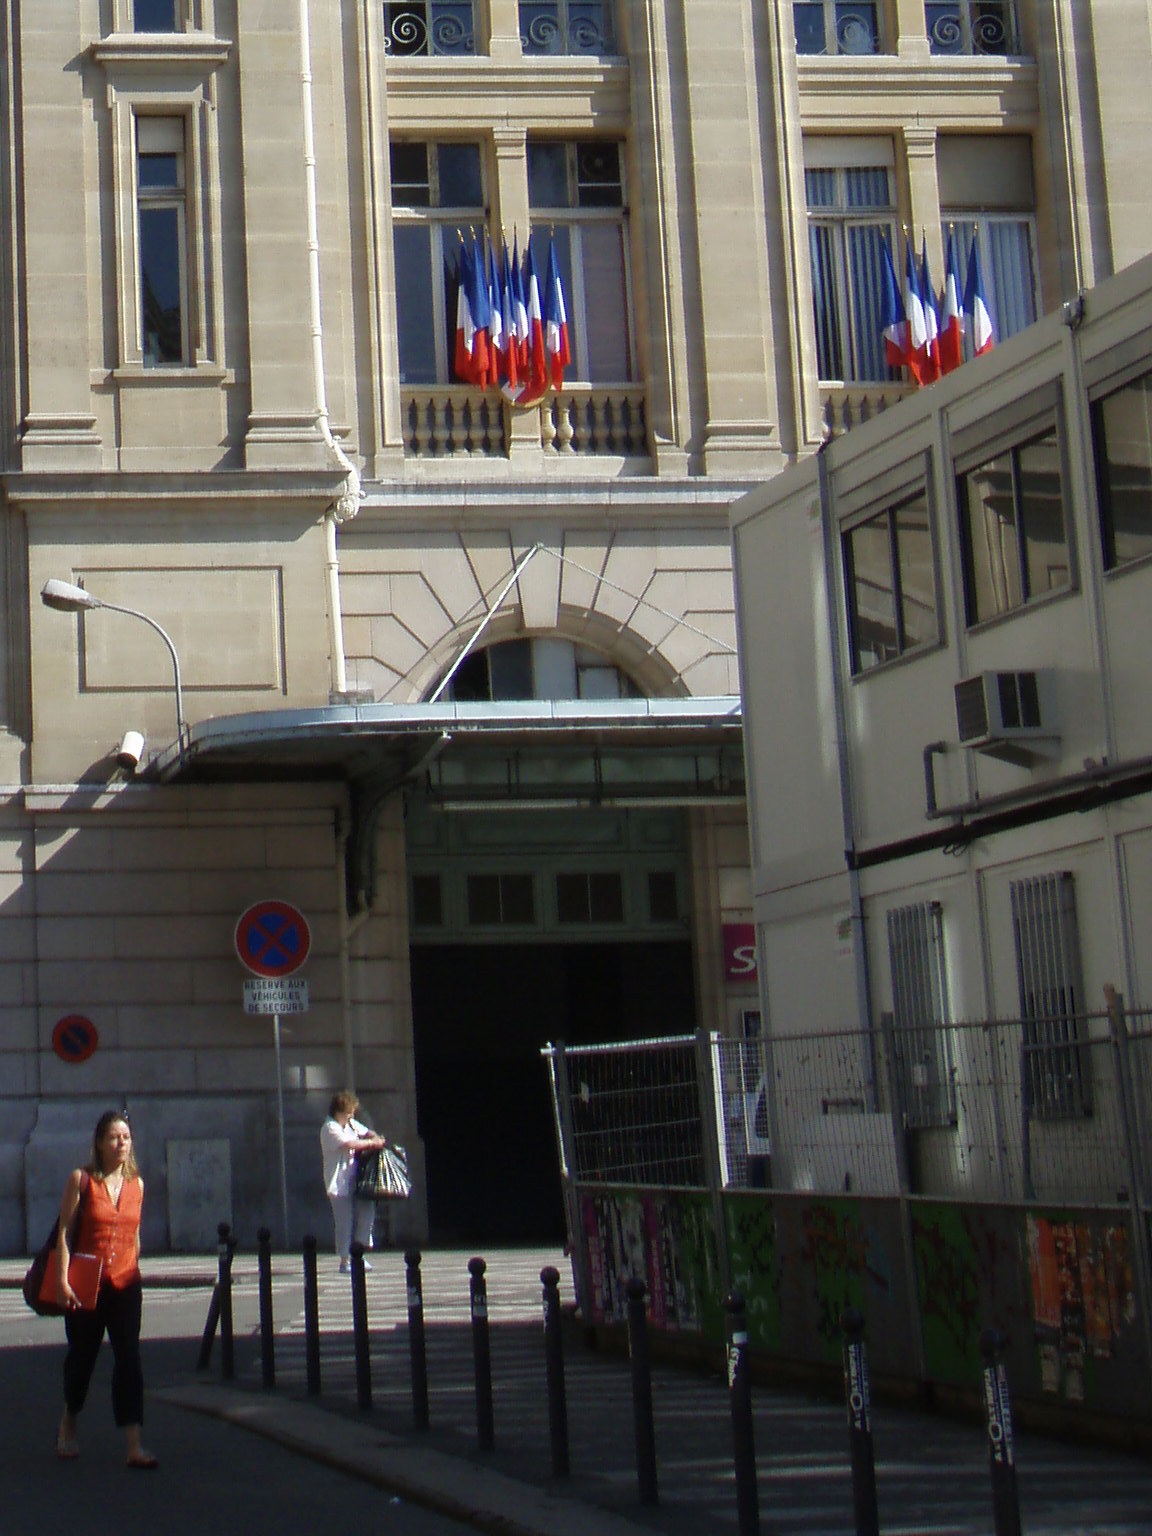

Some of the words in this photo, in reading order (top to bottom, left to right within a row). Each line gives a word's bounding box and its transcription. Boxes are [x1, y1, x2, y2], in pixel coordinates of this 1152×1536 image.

[288, 979, 306, 989] AUX
[248, 1002, 260, 1013] DE
[263, 1002, 304, 1012] SECOURS
